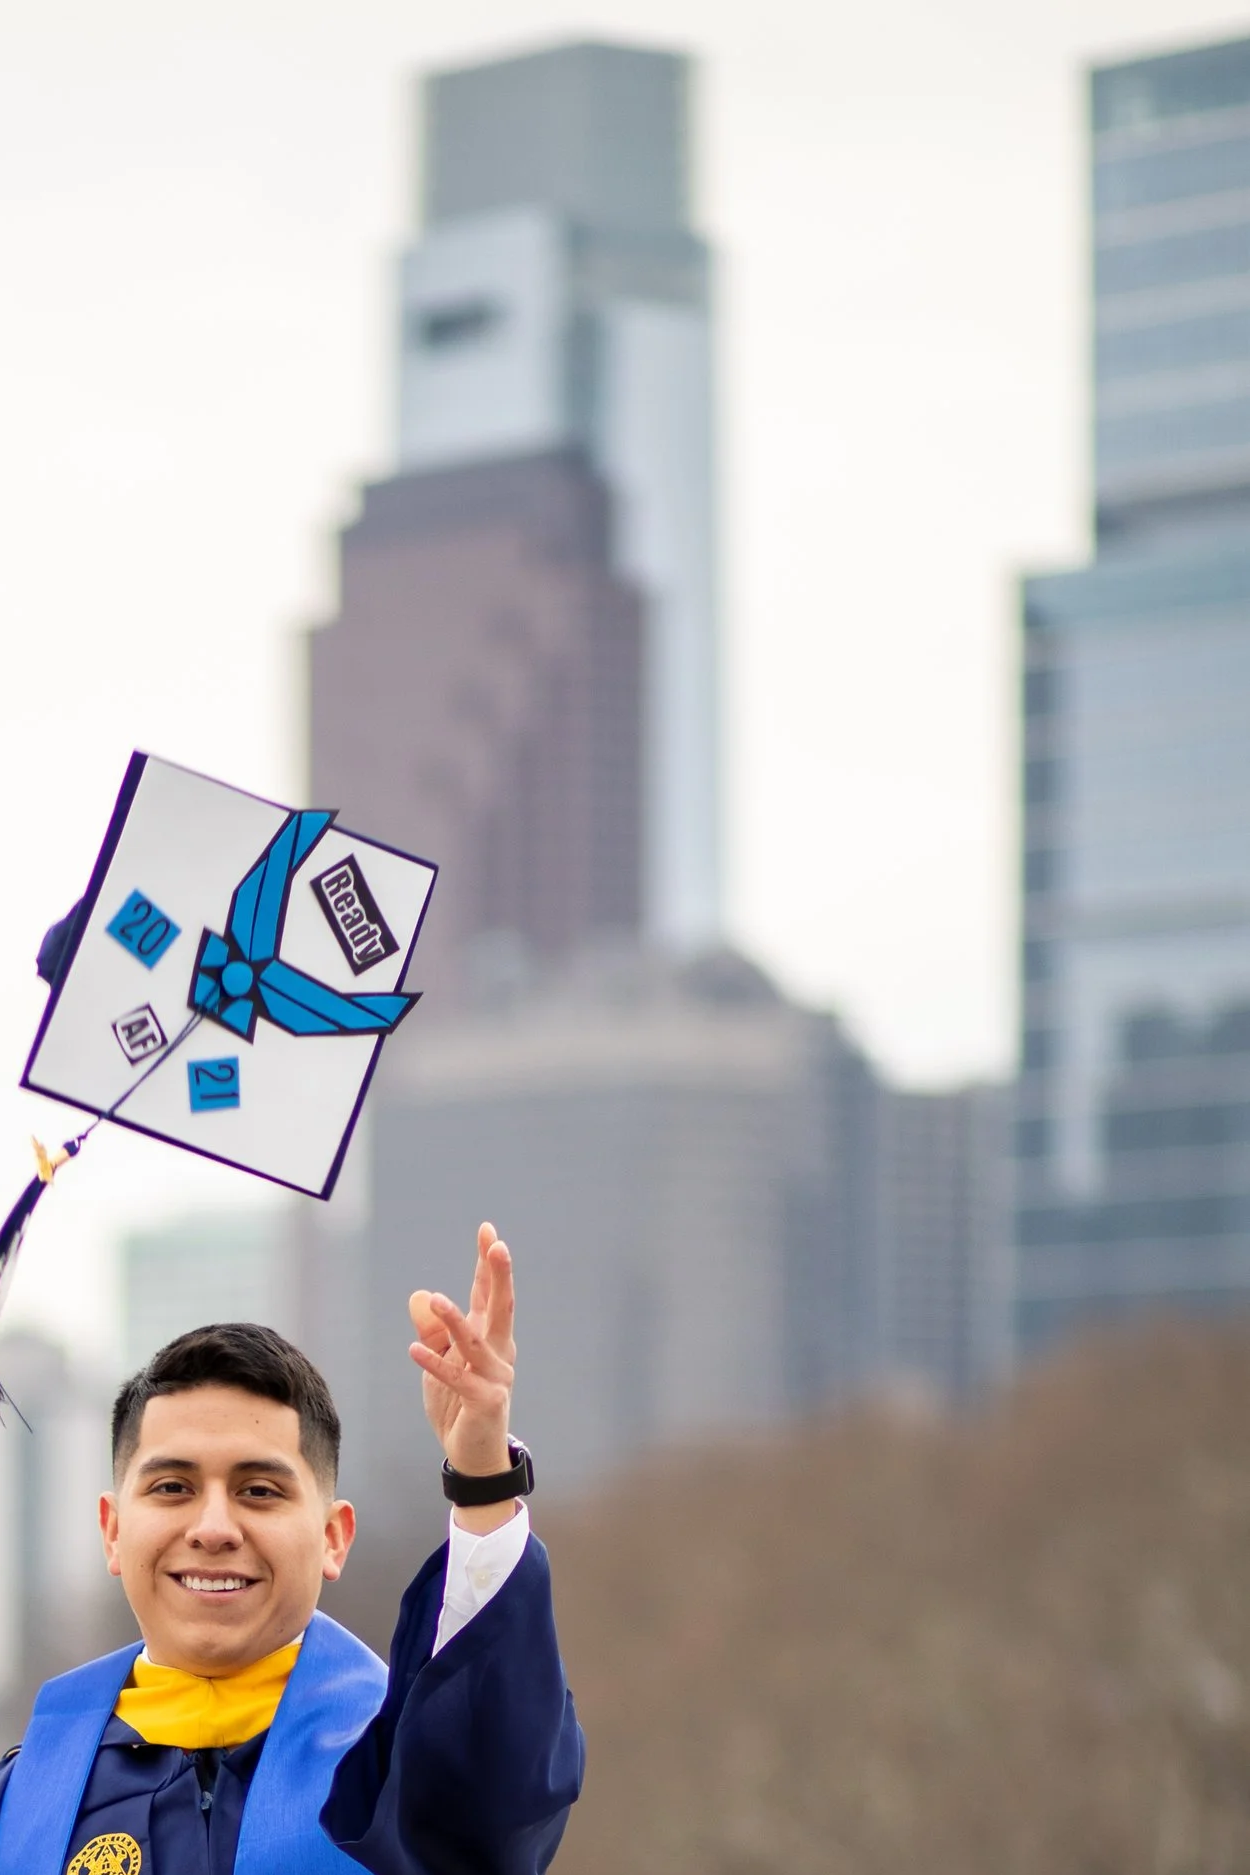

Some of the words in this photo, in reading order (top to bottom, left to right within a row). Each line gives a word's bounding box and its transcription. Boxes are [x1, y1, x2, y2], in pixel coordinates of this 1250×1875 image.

[119, 900, 171, 955] 20
[323, 866, 384, 962] Ready
[121, 1016, 158, 1051] AF
[194, 1064, 239, 1101] 21
